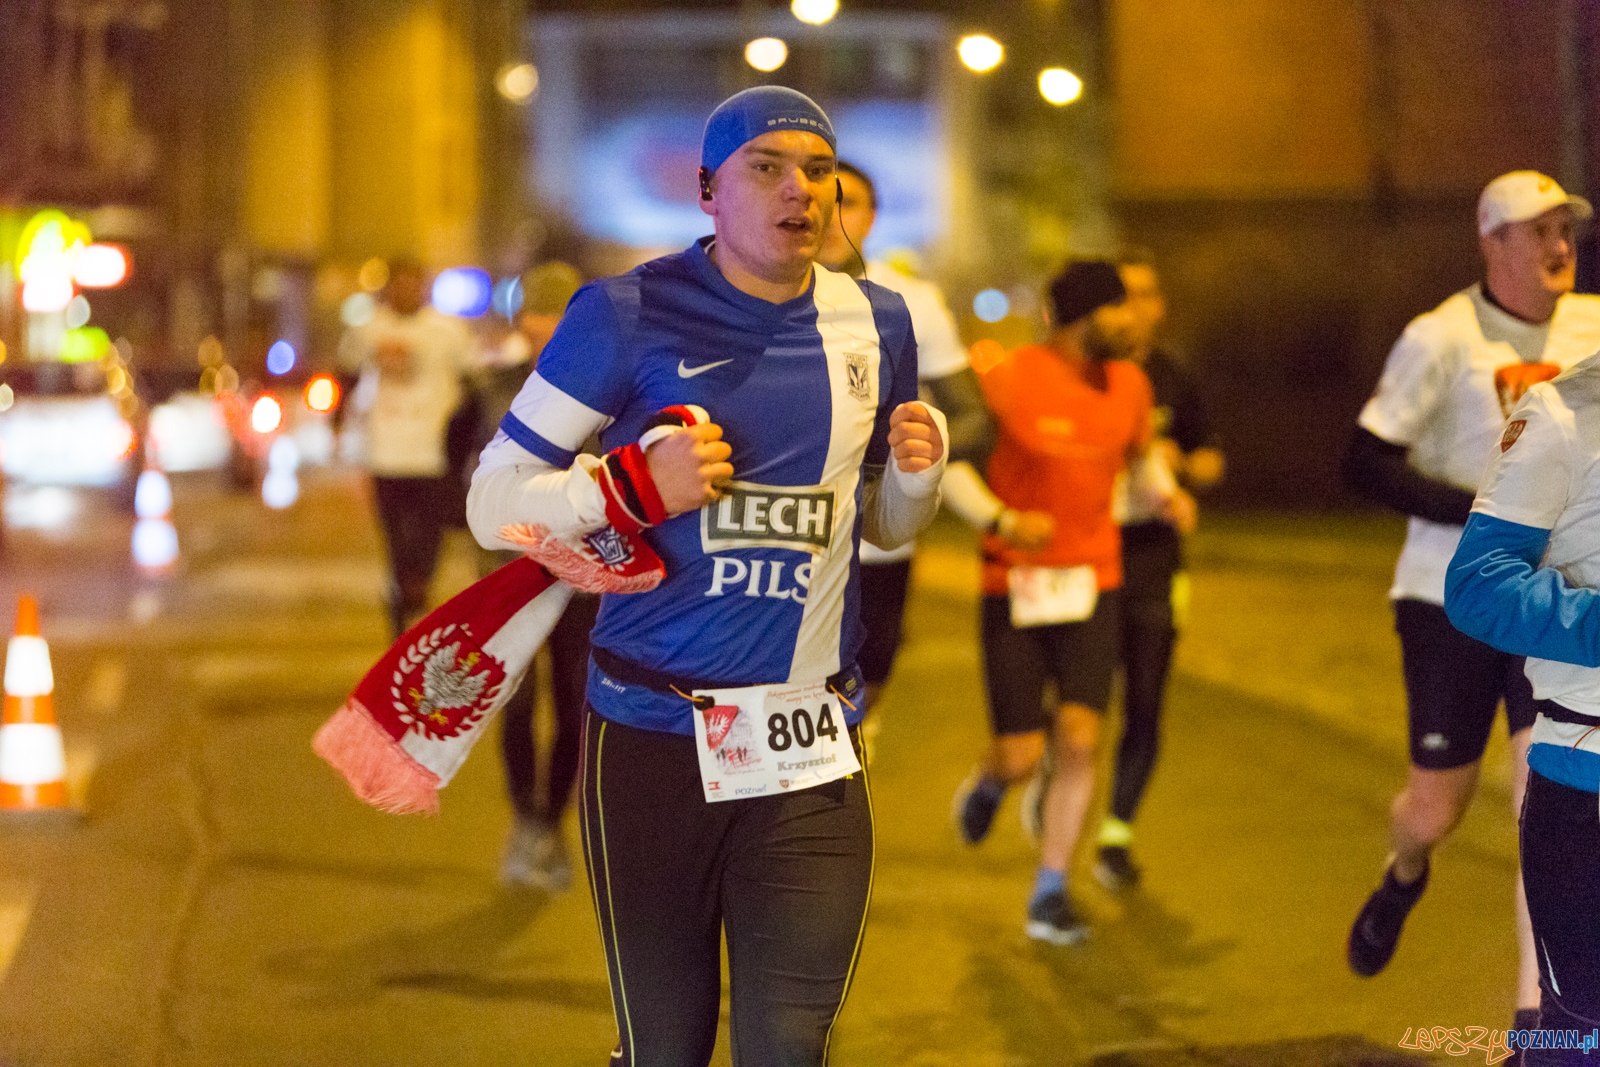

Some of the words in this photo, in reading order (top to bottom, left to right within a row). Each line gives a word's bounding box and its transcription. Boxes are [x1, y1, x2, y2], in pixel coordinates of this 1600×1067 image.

[717, 495, 827, 536] LECH
[704, 556, 812, 605] PILS
[767, 703, 838, 752] 804
[777, 753, 837, 772] Krzysztof
